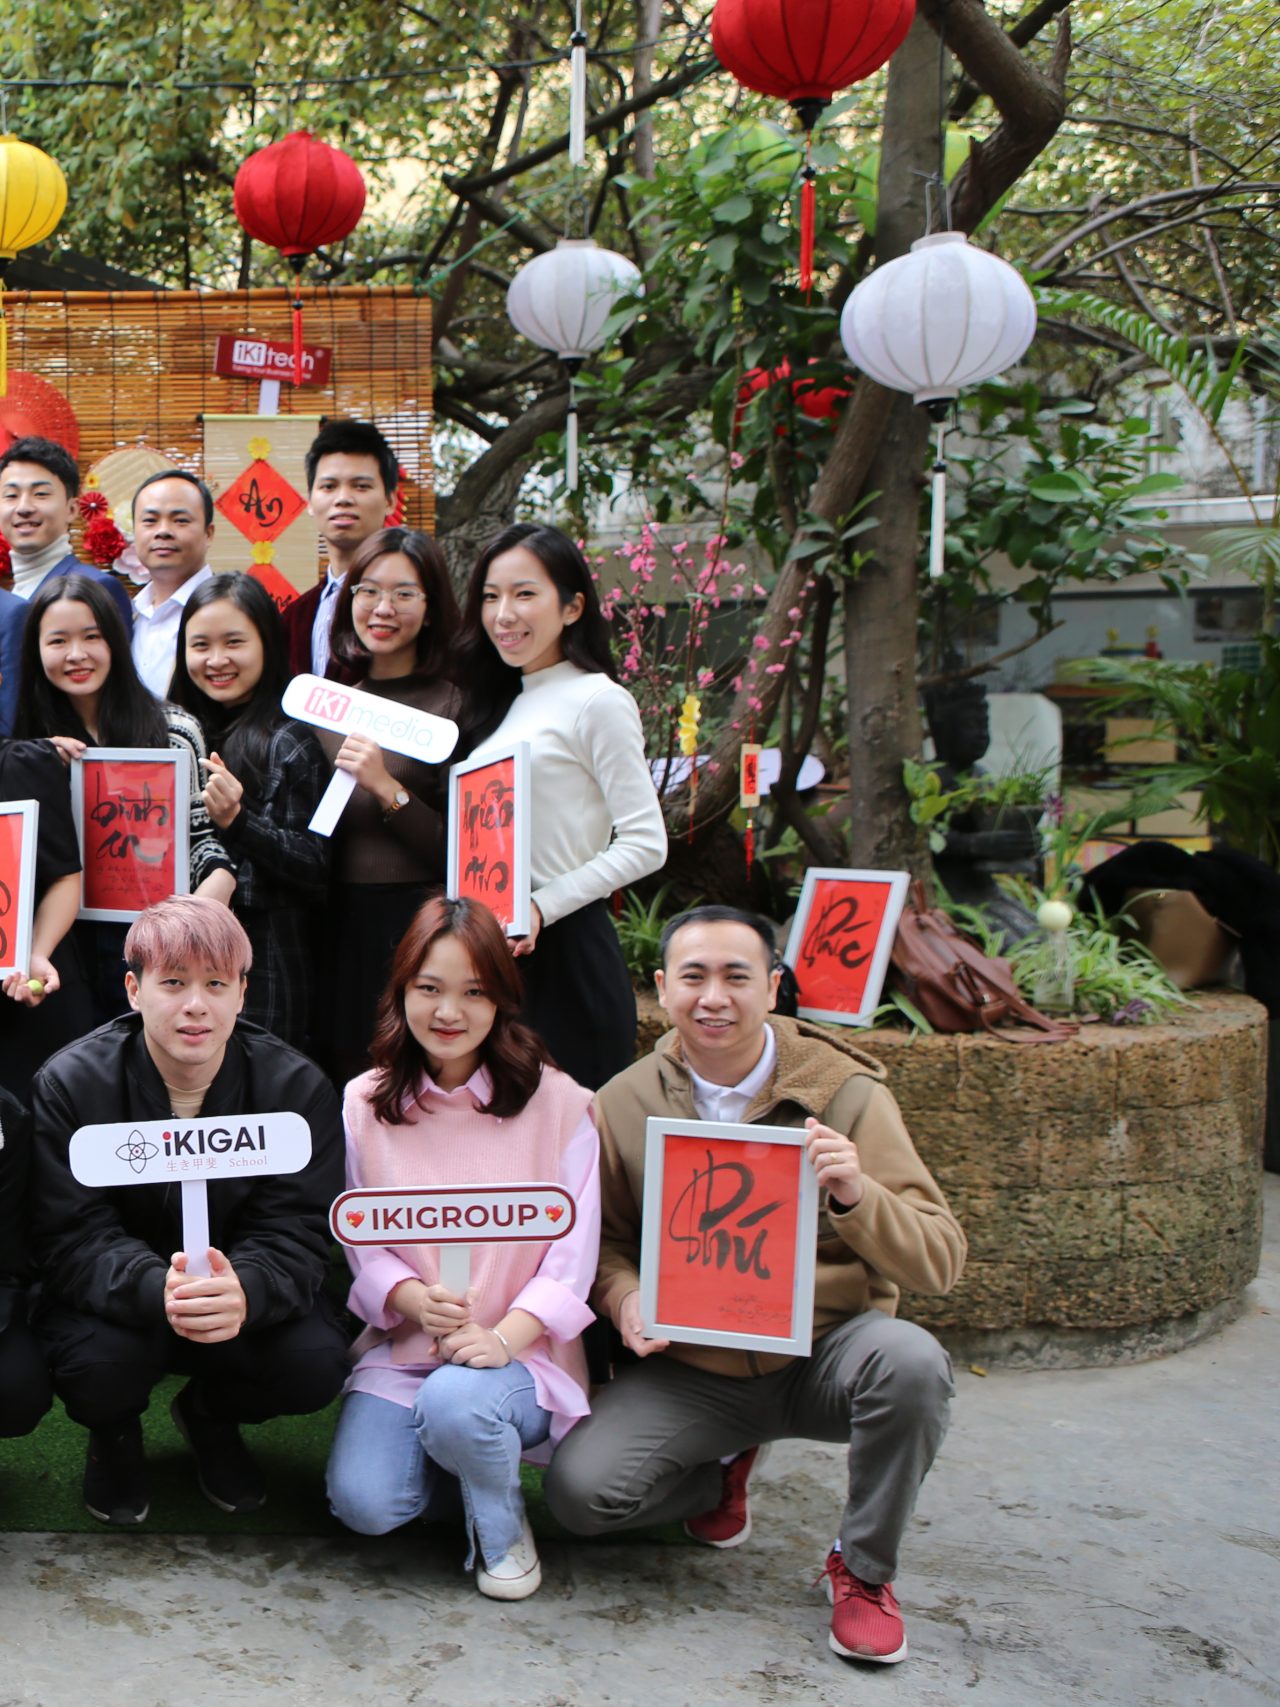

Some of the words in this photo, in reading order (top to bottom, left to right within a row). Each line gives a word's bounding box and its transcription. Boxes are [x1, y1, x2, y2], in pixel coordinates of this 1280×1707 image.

[166, 1158, 217, 1173] 生き甲斐
[229, 1156, 268, 1169] School
[372, 1204, 538, 1230] IKIGROUP
